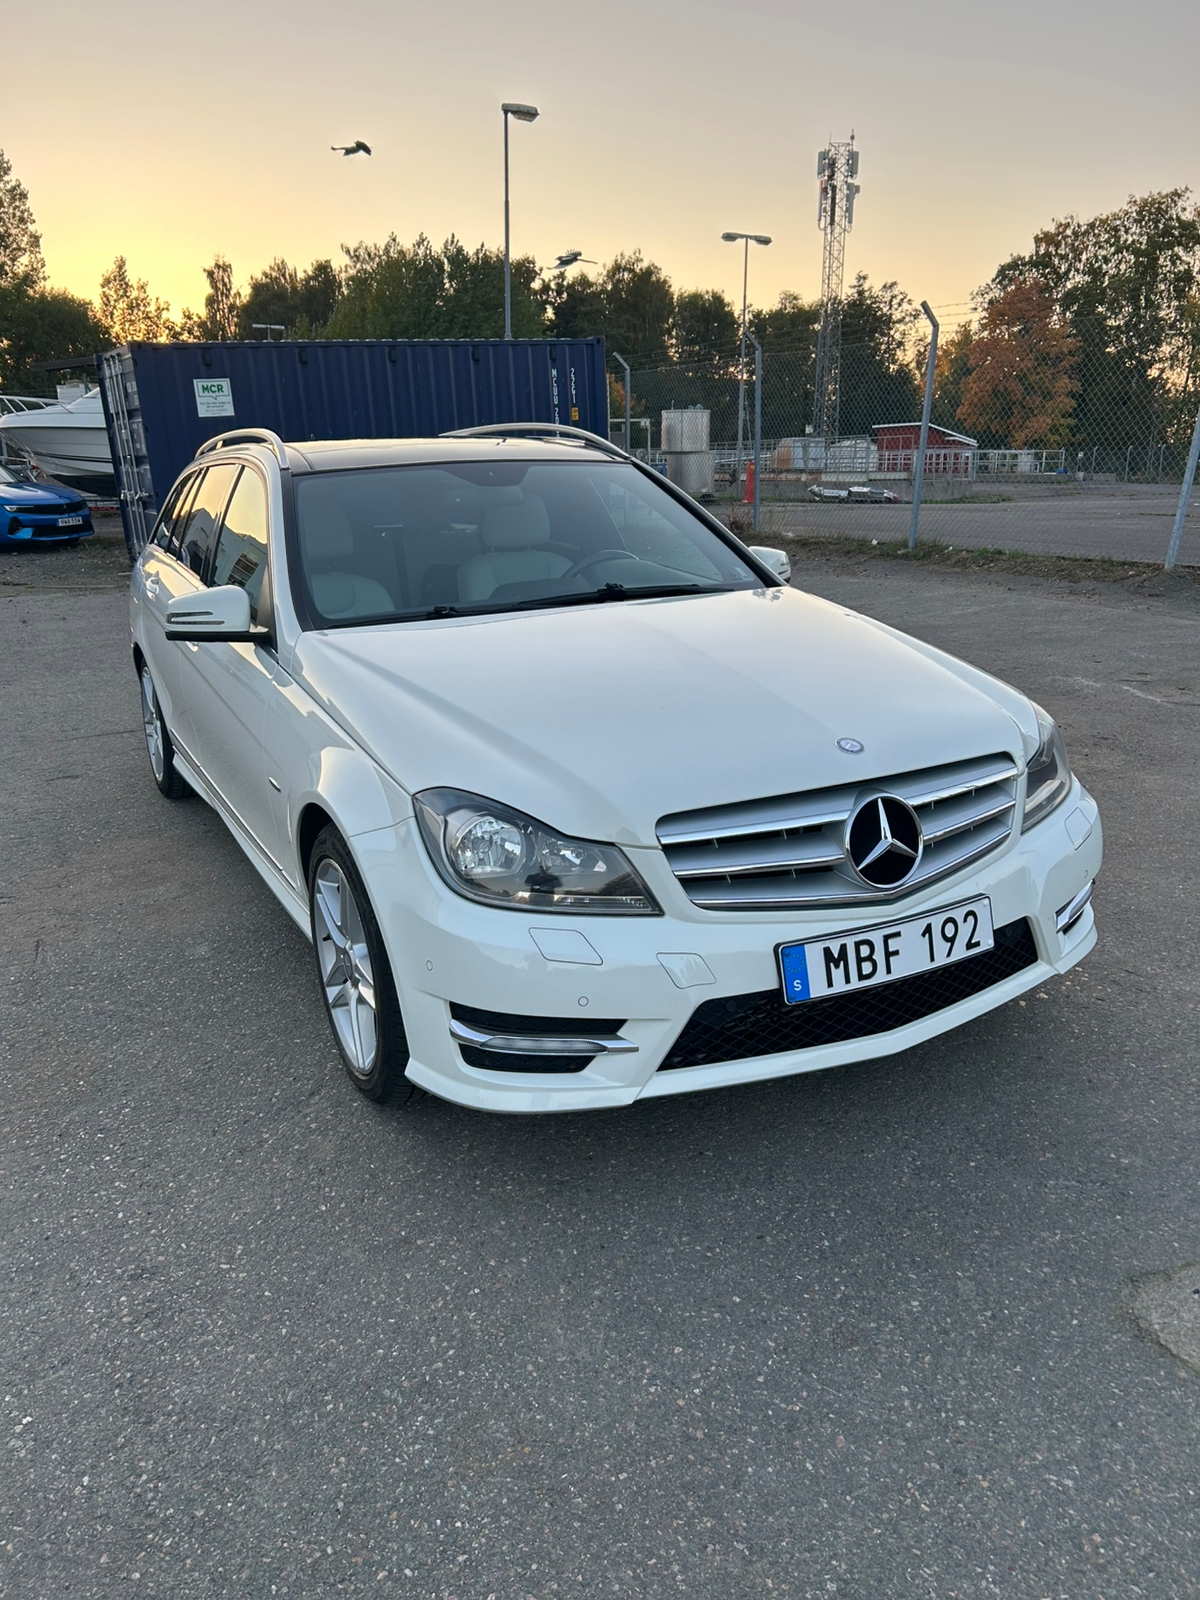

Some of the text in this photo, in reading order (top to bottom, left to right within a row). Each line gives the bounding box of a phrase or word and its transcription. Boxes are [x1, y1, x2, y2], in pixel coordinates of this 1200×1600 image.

[201, 384, 224, 394] MCR
[551, 368, 559, 405] MCUU
[822, 909, 981, 989] MBF 192
[793, 979, 802, 991] S
